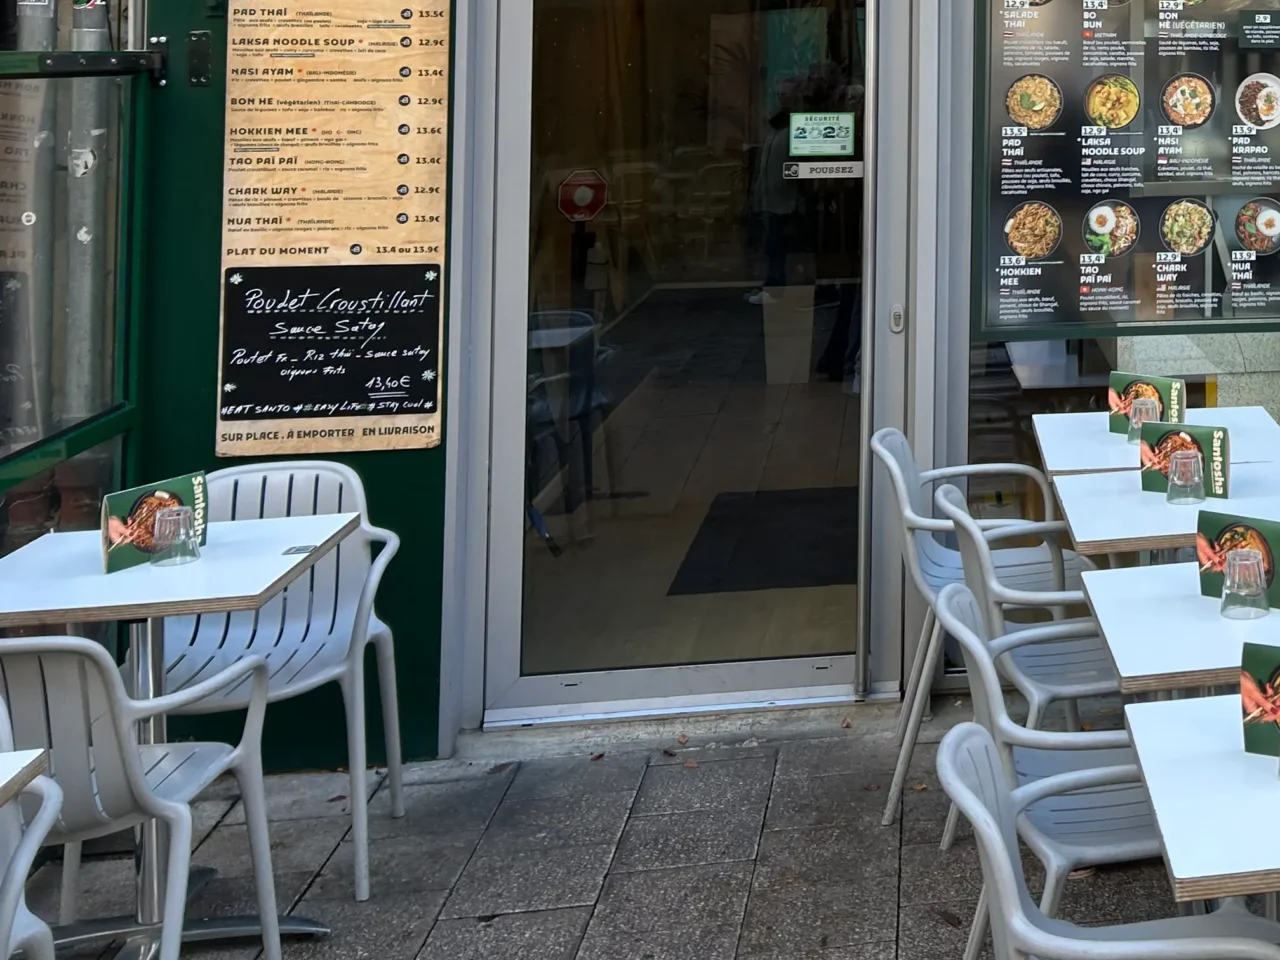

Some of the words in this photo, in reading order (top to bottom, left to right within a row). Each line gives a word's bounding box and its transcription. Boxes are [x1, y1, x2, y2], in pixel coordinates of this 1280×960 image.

[233, 8, 257, 16] PAD
[261, 8, 287, 16] THAÏ
[419, 10, 444, 18] 13.5€
[232, 38, 269, 46] LAKSA
[273, 38, 320, 46] NOODLE
[324, 38, 355, 46] SOUP
[231, 68, 259, 76] NASI
[262, 68, 293, 76] AYAM
[418, 69, 443, 77] 13.4€
[285, 127, 308, 135] MEE
[229, 157, 252, 165] TAO
[257, 156, 275, 165] PAÏ
[279, 156, 298, 164] PAÏ
[228, 187, 267, 195] CHARK
[272, 187, 298, 195] WAY
[414, 186, 440, 194] 12.9€
[228, 217, 251, 225] NUA
[255, 216, 282, 225] THAÏ
[414, 215, 440, 223] 13.9€
[227, 248, 256, 256] PLAT
[260, 247, 276, 255] DU
[279, 247, 329, 255] MOMENT
[376, 246, 396, 254] 13.4
[365, 376, 411, 390] 13,40€
[222, 433, 243, 441] SUR
[246, 431, 279, 441] PLACE
[296, 429, 354, 439] EMPORTER
[362, 427, 376, 436] EN
[378, 425, 435, 435] LIVRAISON
[1212, 430, 1225, 495] Santosha
